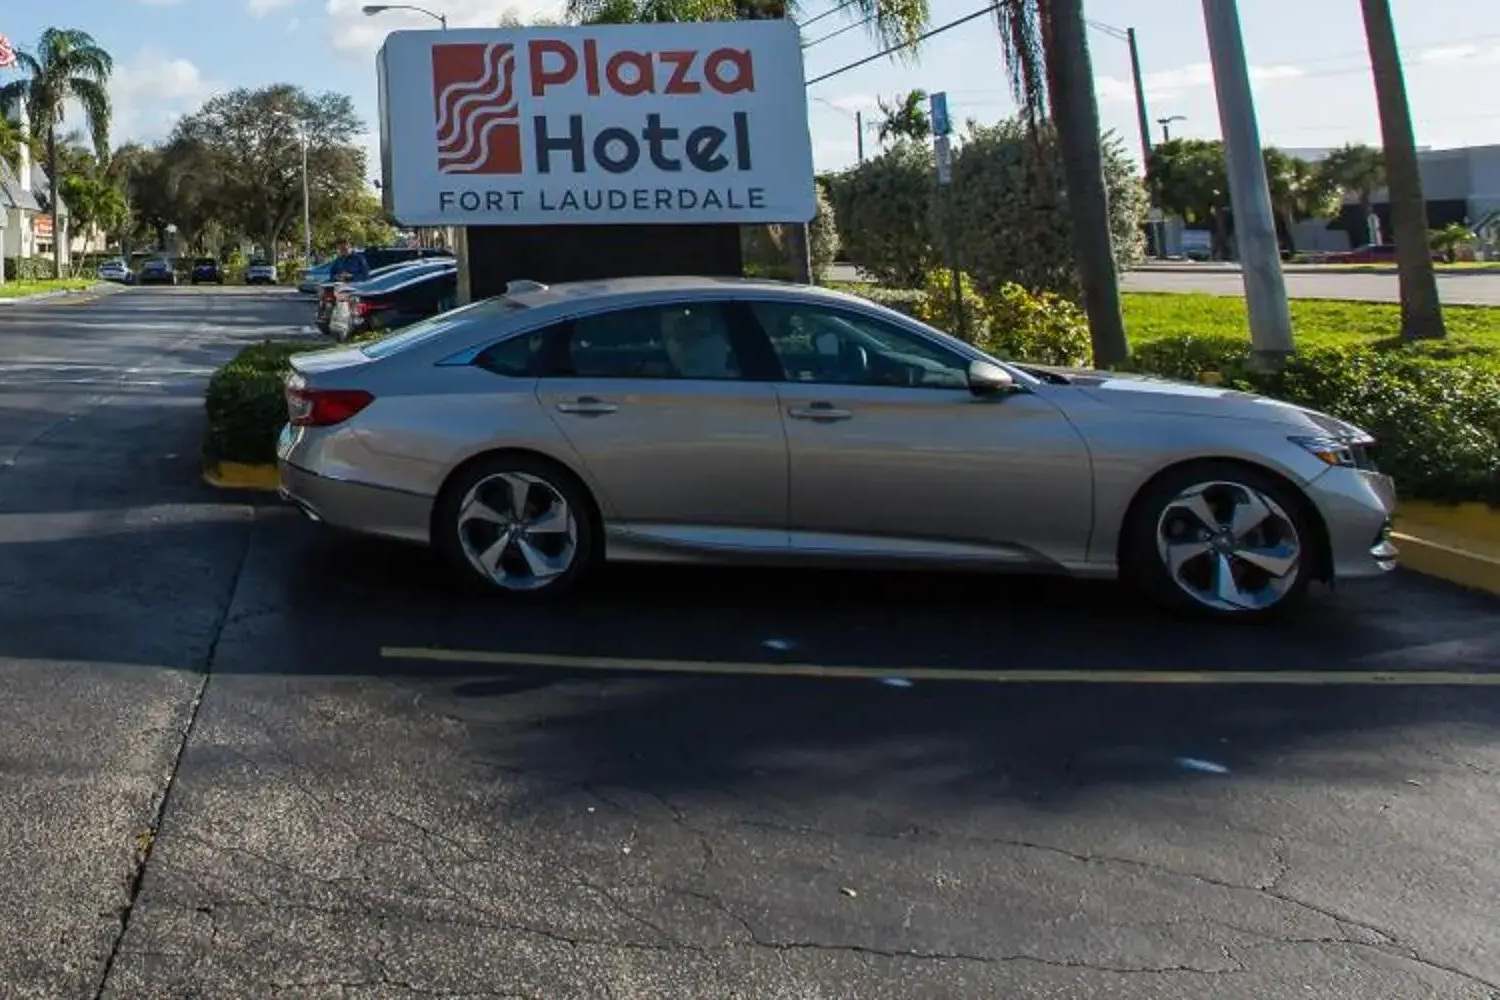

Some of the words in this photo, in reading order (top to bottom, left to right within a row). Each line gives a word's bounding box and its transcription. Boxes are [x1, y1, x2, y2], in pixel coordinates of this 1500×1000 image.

[528, 38, 755, 97] Plaza
[533, 111, 752, 174] Hotel
[439, 190, 524, 211] FORT
[539, 188, 765, 211] LAUDERDALE
